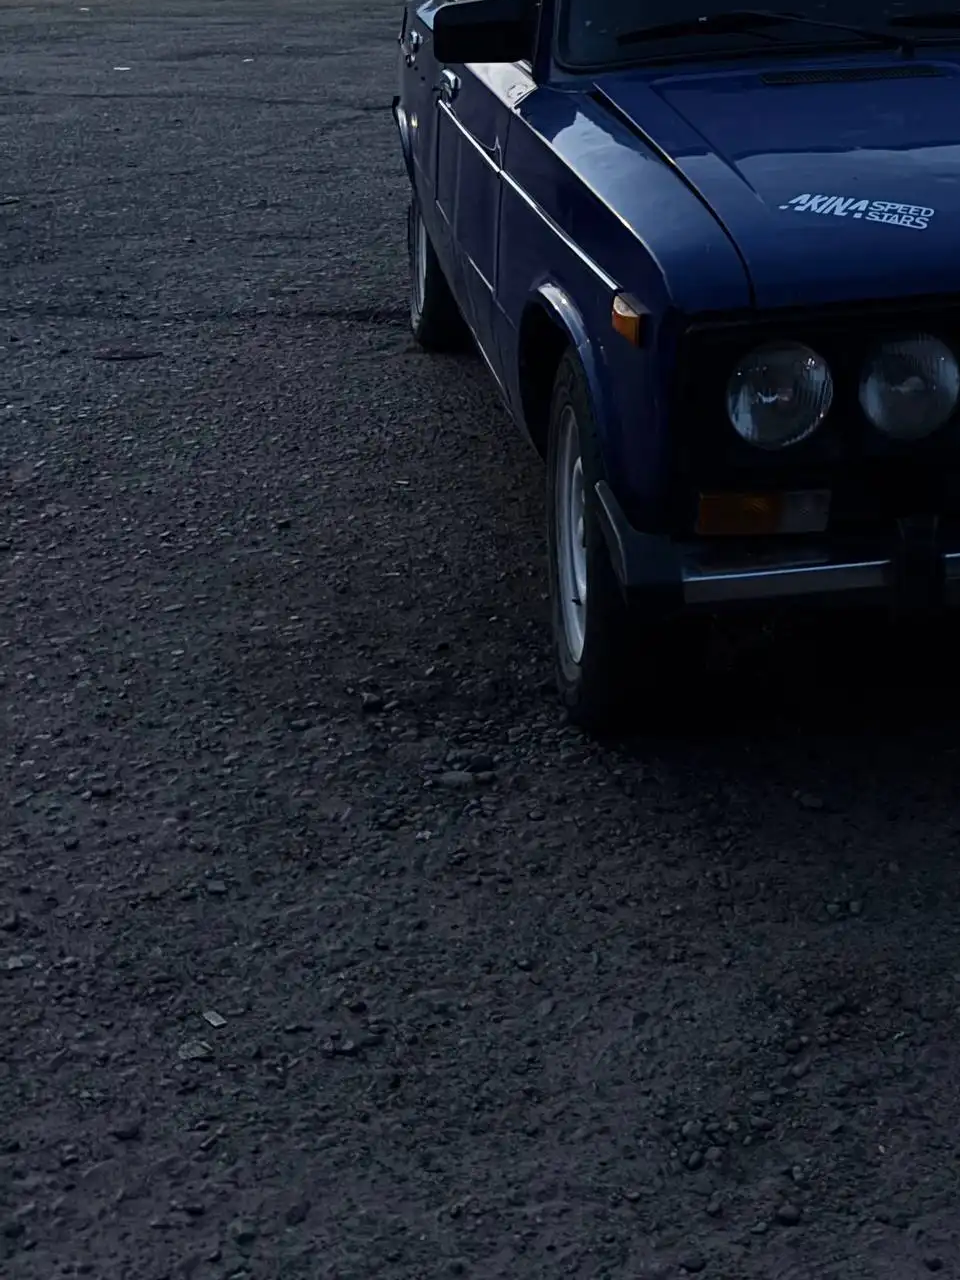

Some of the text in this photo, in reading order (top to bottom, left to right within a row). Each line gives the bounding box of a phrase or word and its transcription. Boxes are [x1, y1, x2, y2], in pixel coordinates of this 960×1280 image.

[778, 193, 935, 218] AKINA SPEED
[864, 211, 931, 231] STARS
